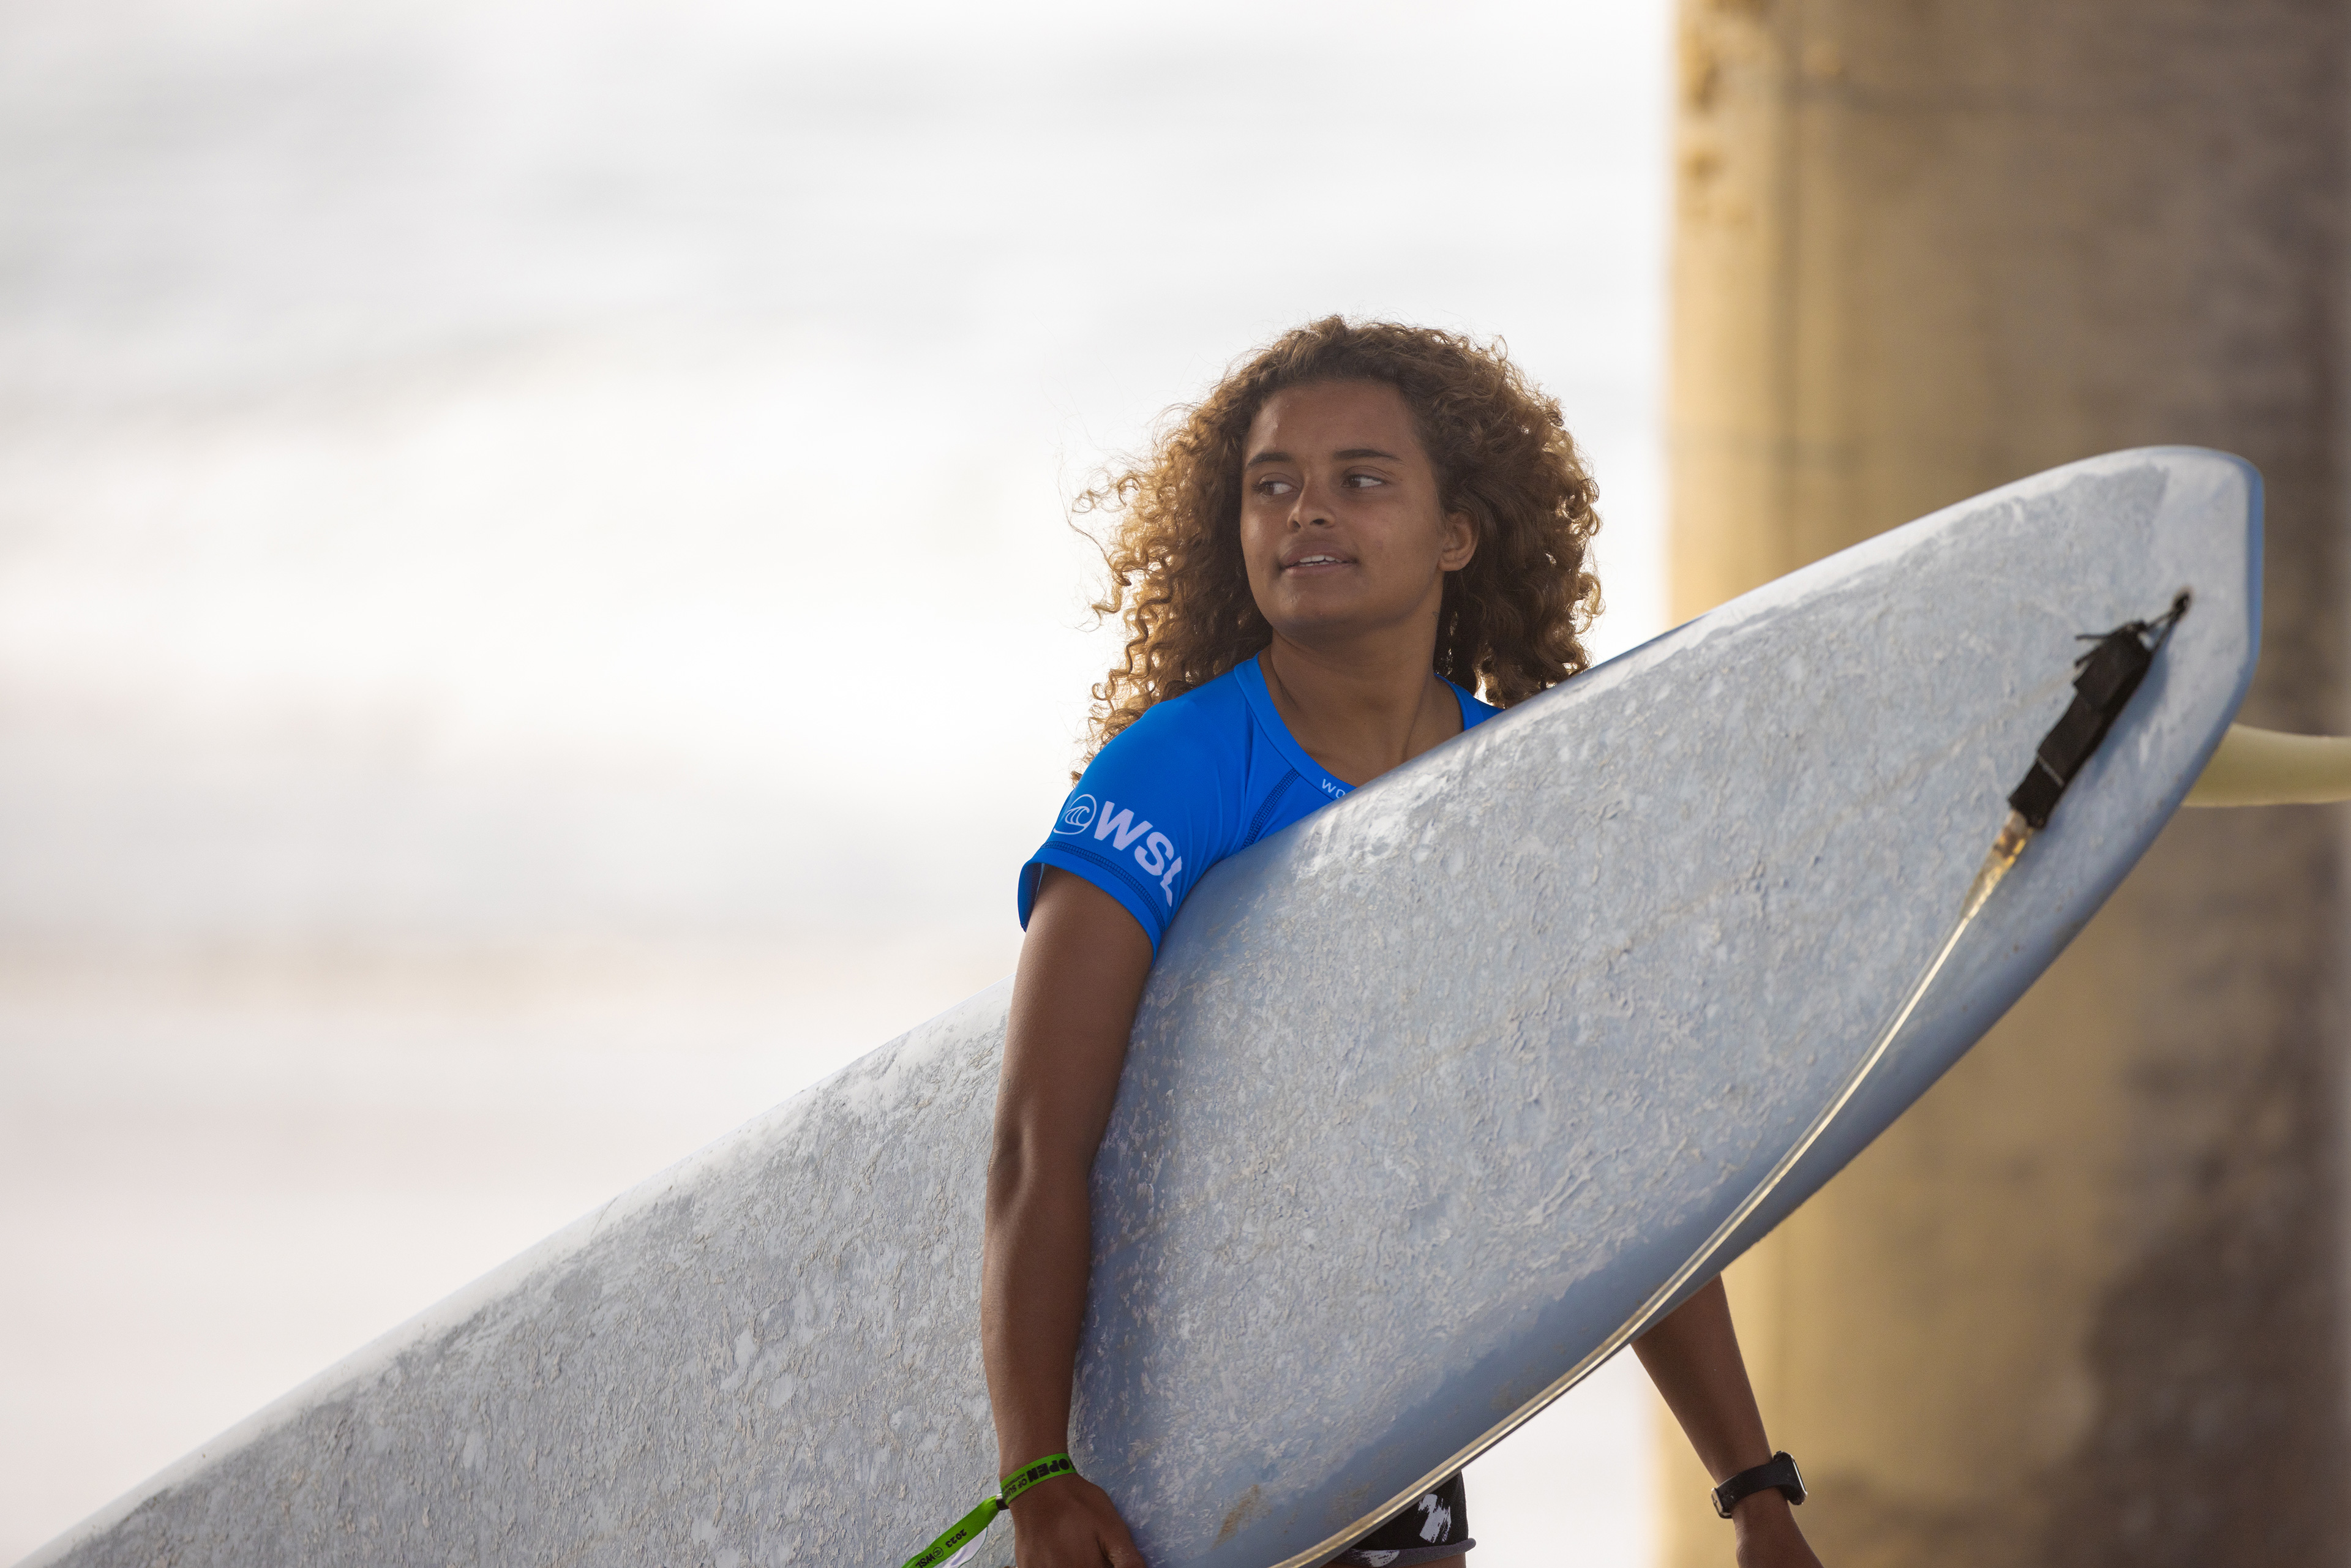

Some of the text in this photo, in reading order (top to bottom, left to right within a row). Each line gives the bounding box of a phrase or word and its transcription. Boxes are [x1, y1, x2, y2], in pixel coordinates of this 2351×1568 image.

[1093, 800, 1183, 907] WSL
[1018, 1478, 1027, 1488] OF
[1026, 1458, 1070, 1482] OPEN
[915, 1528, 967, 1568] 2023 WSL
